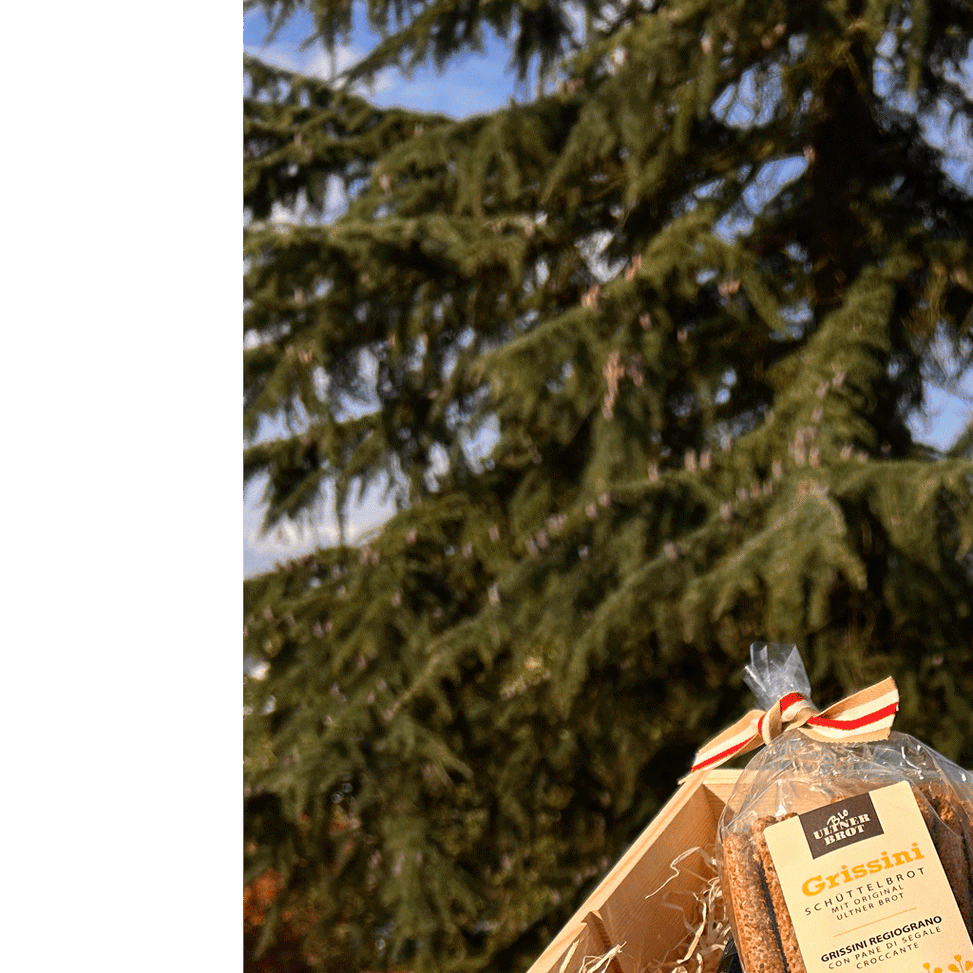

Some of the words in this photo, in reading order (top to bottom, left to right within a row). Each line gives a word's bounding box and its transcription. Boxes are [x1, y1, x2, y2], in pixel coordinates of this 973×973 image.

[813, 813, 871, 840] ULTNER
[827, 808, 849, 826] Bio
[824, 824, 865, 846] BROT
[801, 842, 925, 897] Grissini
[804, 867, 926, 916] SCHÜTTELBROT
[831, 901, 849, 914] MIT
[853, 884, 904, 906] ORIGINAL
[836, 902, 875, 921] ULTNER
[878, 892, 905, 909] BROT
[821, 940, 868, 964] GRISSINI
[869, 915, 943, 946] REGIOGRANO
[828, 957, 851, 970] CON
[855, 946, 882, 961] PANE
[886, 939, 898, 950] DI
[901, 925, 942, 945] SEGALE
[856, 942, 921, 970] CROCCANTE
